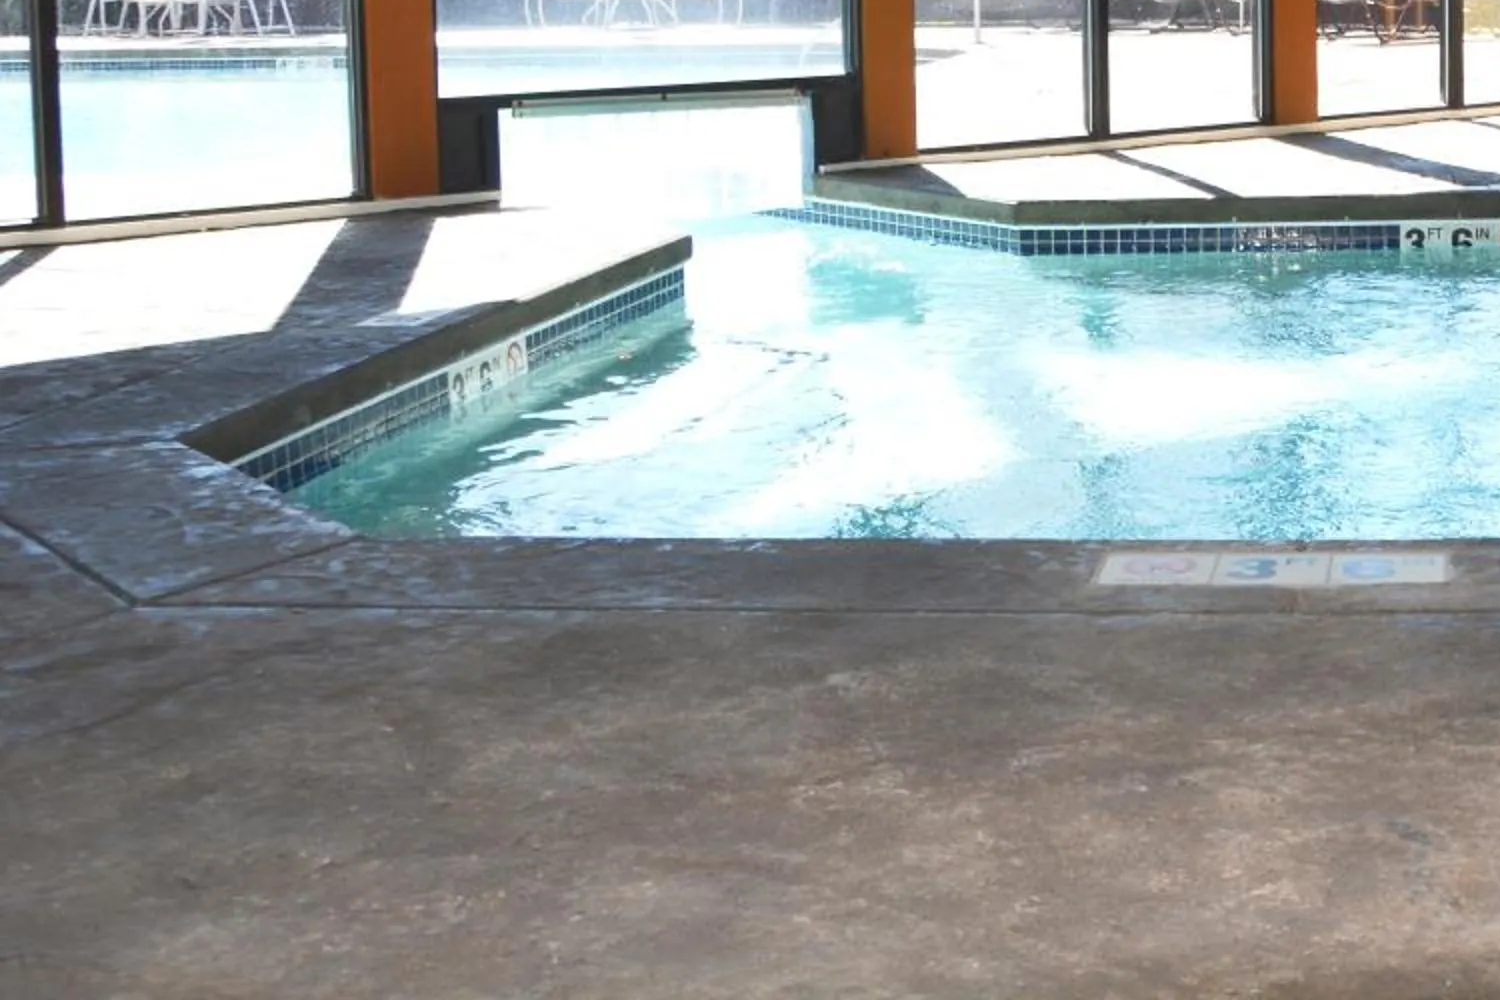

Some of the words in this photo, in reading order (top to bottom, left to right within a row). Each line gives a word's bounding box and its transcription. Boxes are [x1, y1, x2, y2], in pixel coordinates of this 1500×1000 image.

[1428, 227, 1443, 240] FT
[1475, 227, 1490, 239] IN
[1226, 556, 1279, 580] 3
